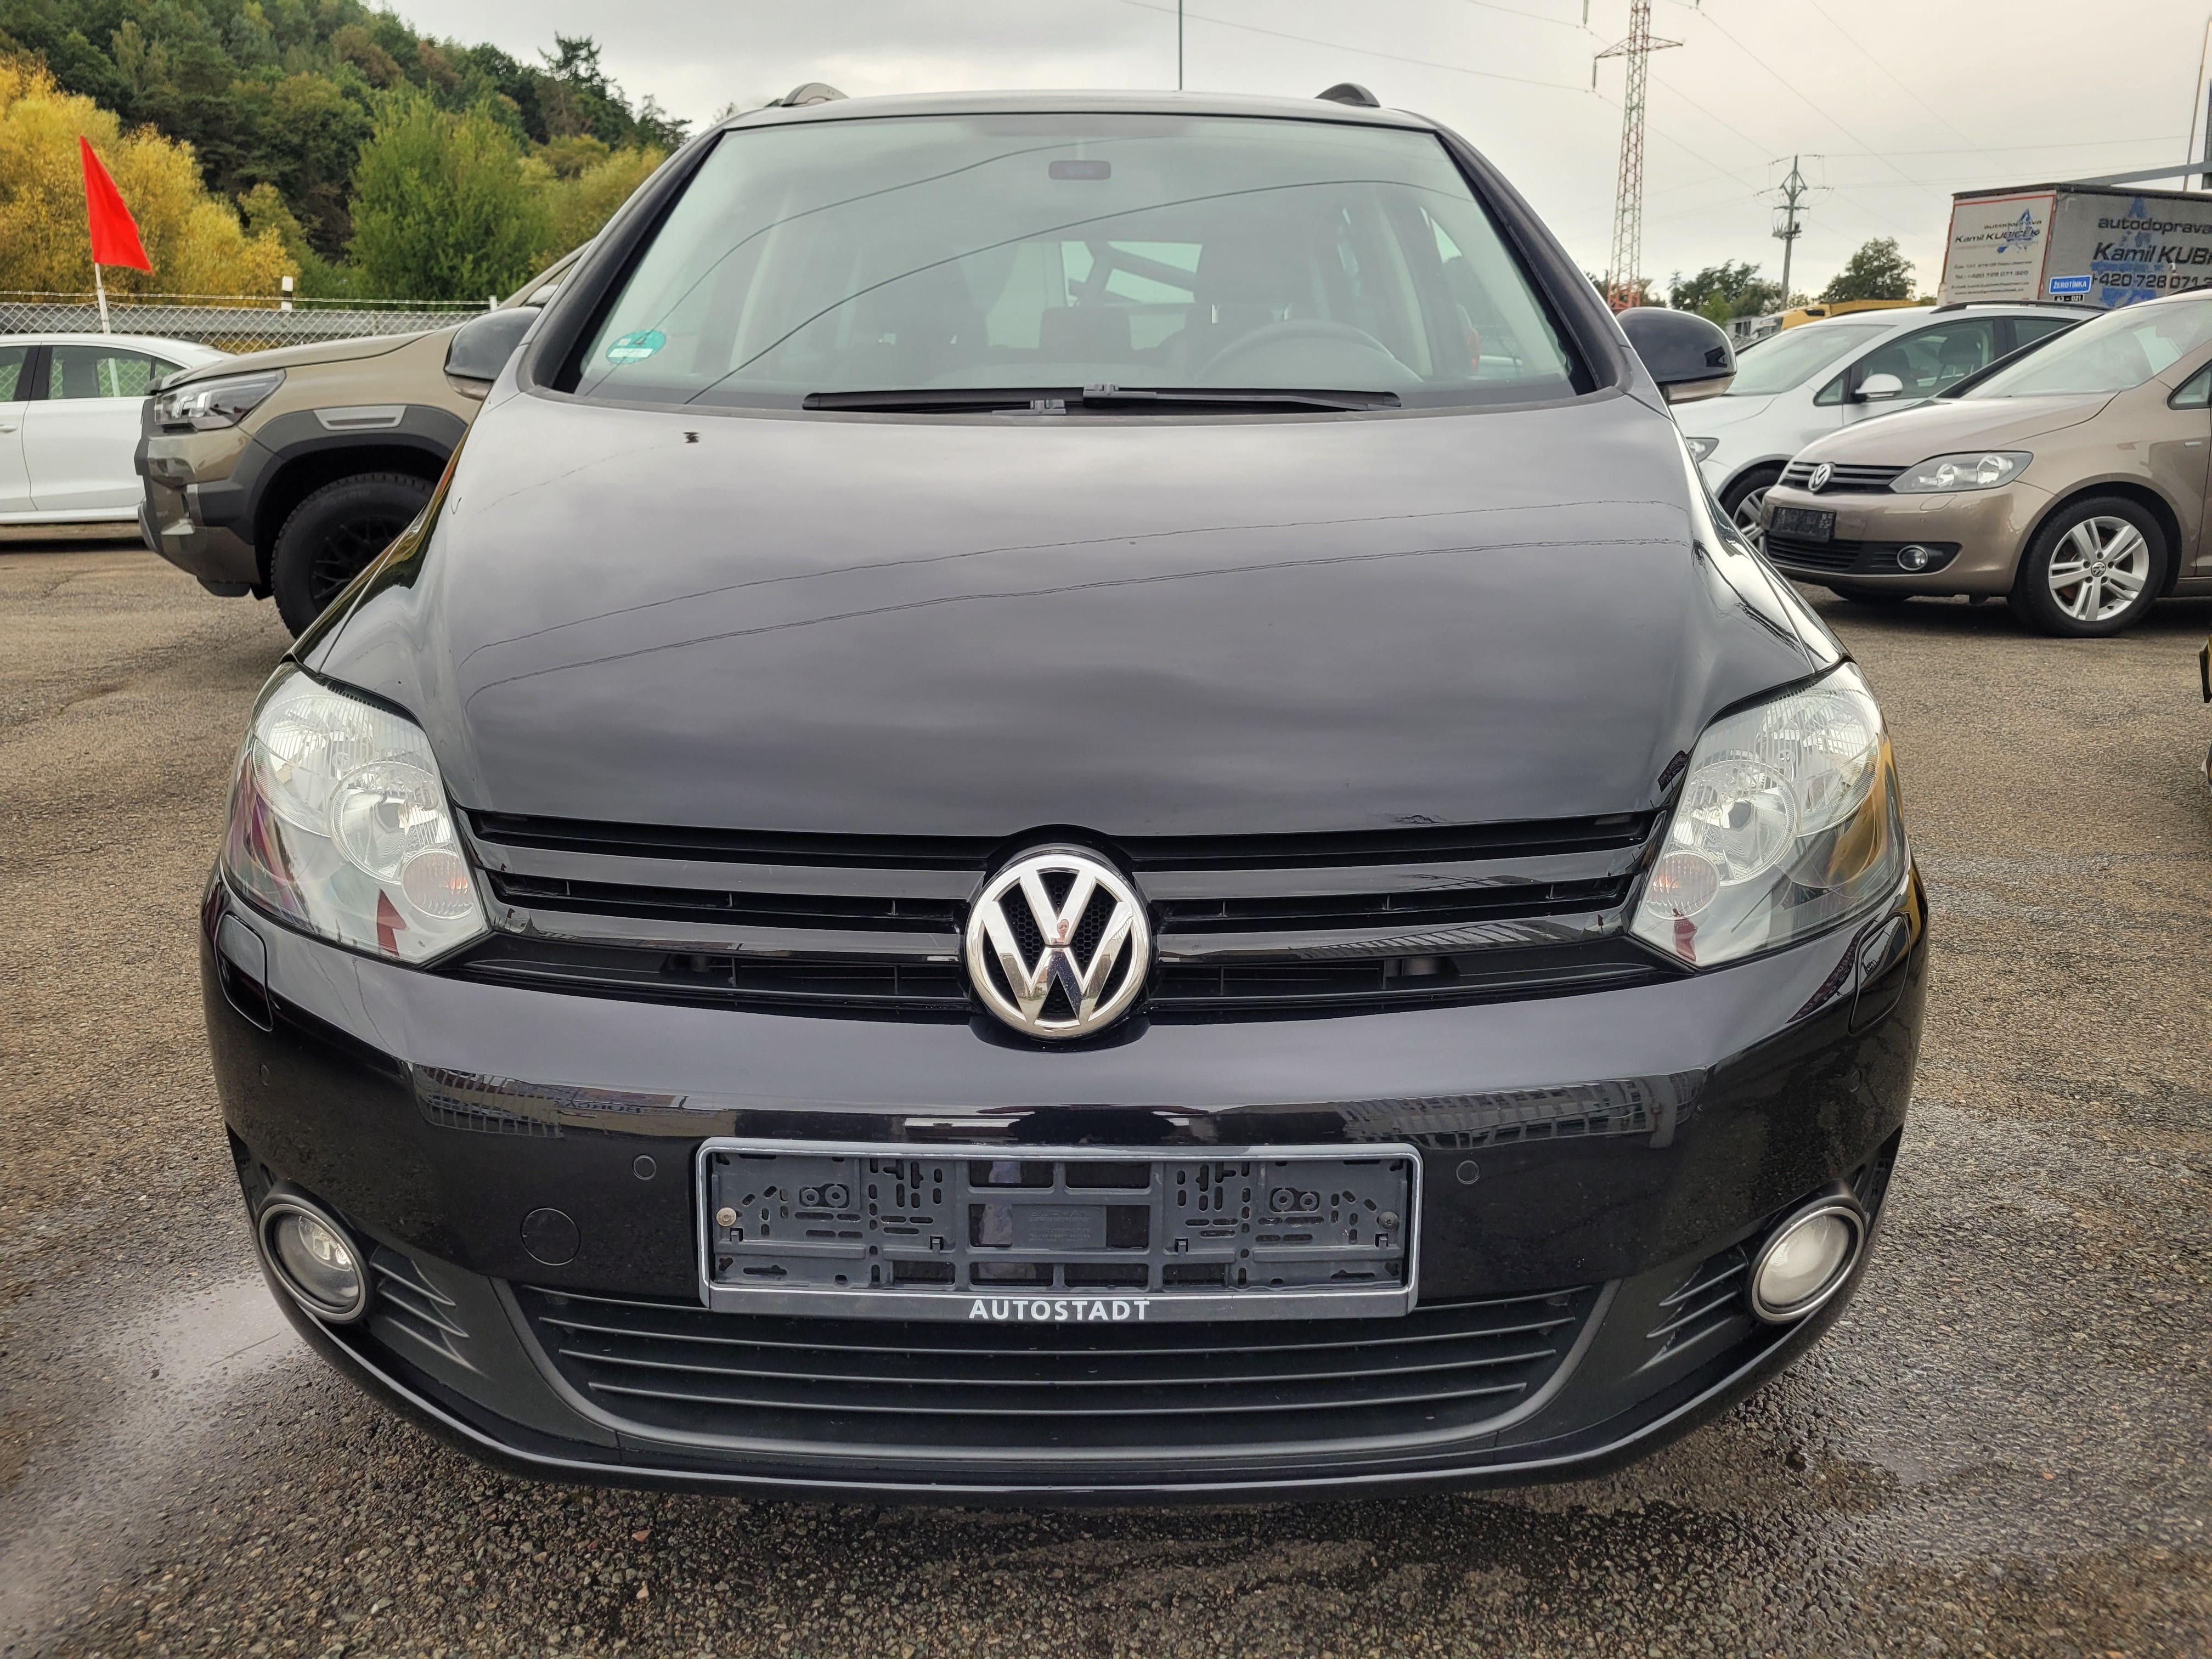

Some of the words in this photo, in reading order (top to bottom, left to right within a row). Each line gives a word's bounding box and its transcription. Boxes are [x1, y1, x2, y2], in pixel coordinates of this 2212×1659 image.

[2098, 218, 2212, 235] autodoprava
[2093, 242, 2157, 262] Kamil
[2137, 274, 2167, 289] 728
[967, 854, 1151, 1039] VW
[968, 1299, 1150, 1321] AUTOSTADT
